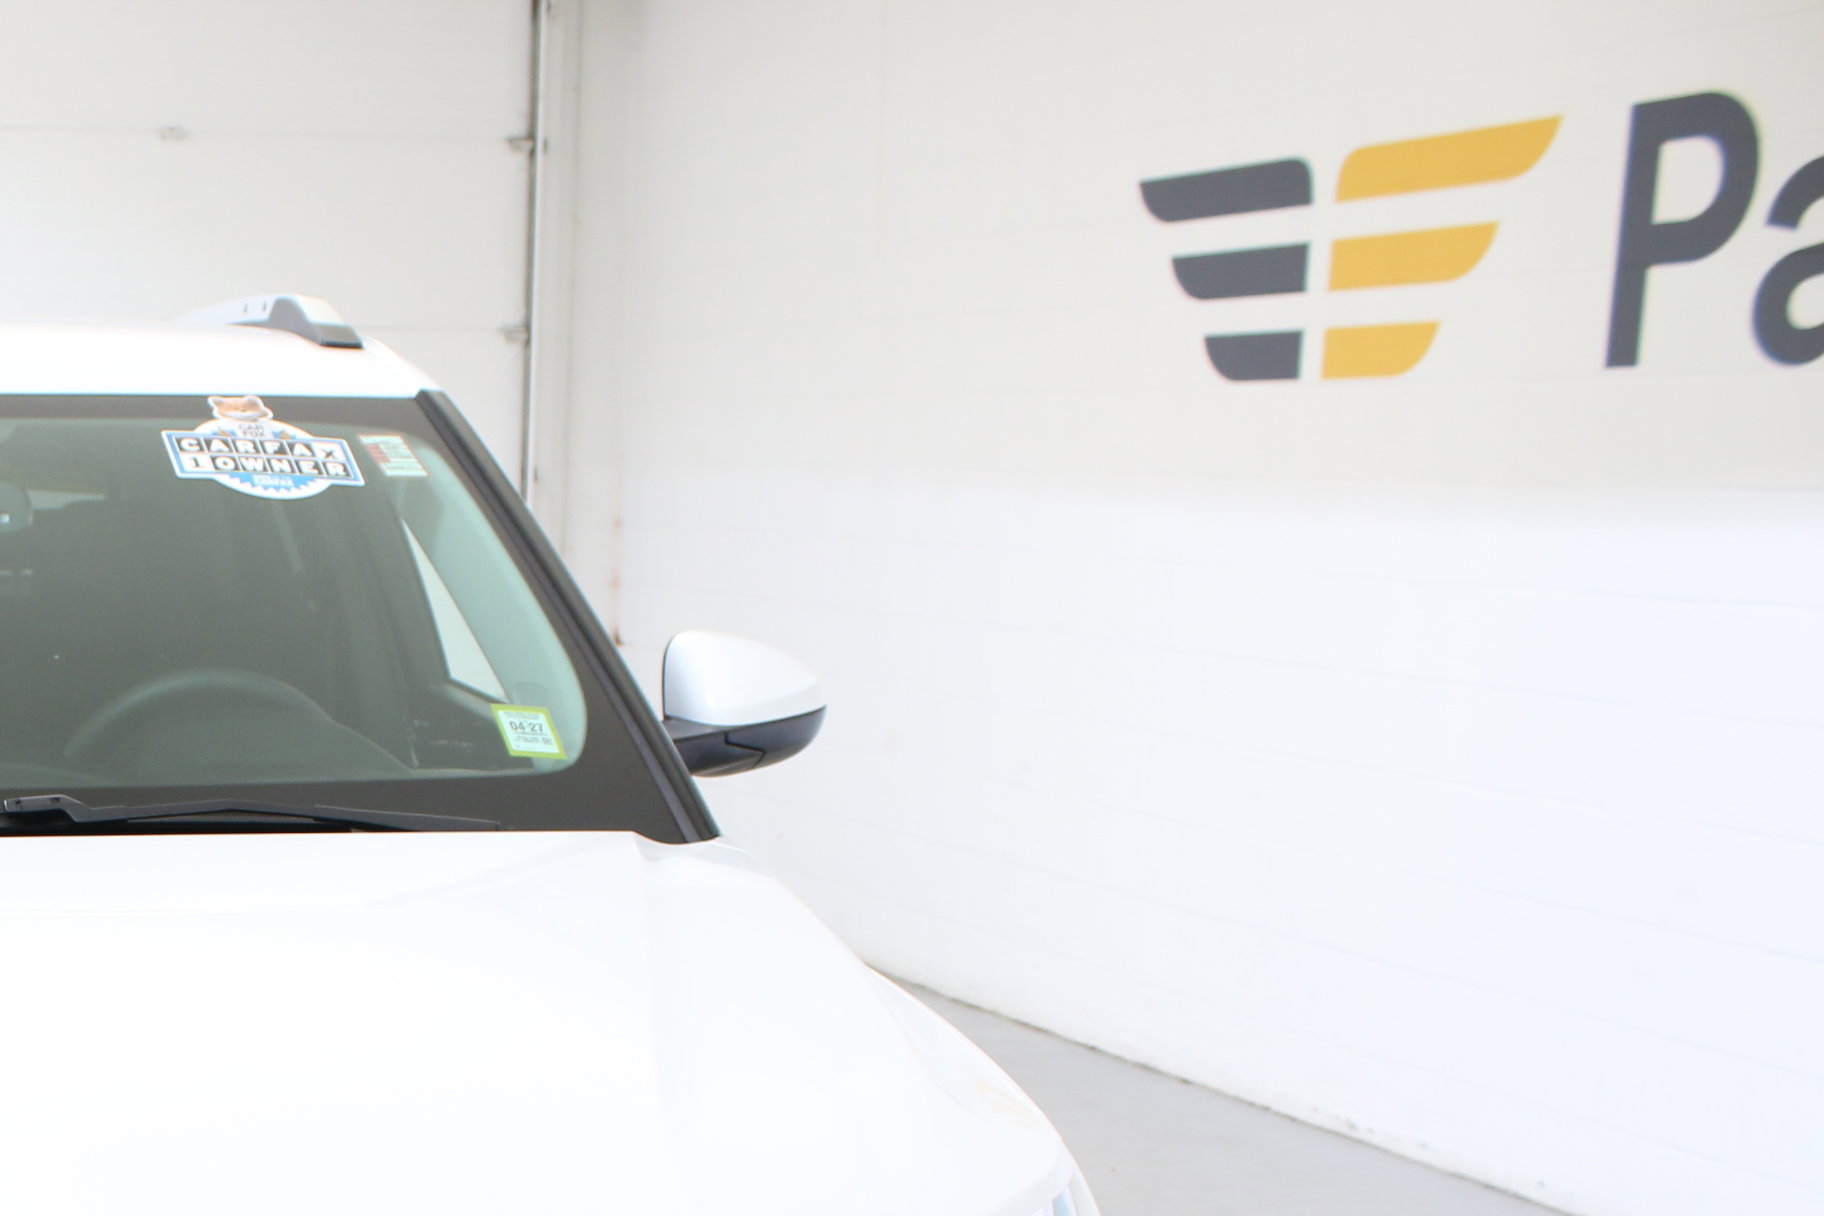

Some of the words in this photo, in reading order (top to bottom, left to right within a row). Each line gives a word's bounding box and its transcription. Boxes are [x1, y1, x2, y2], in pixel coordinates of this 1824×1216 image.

[180, 437, 337, 459] CARFAX
[190, 456, 201, 468] 1
[214, 456, 347, 476] OWNER
